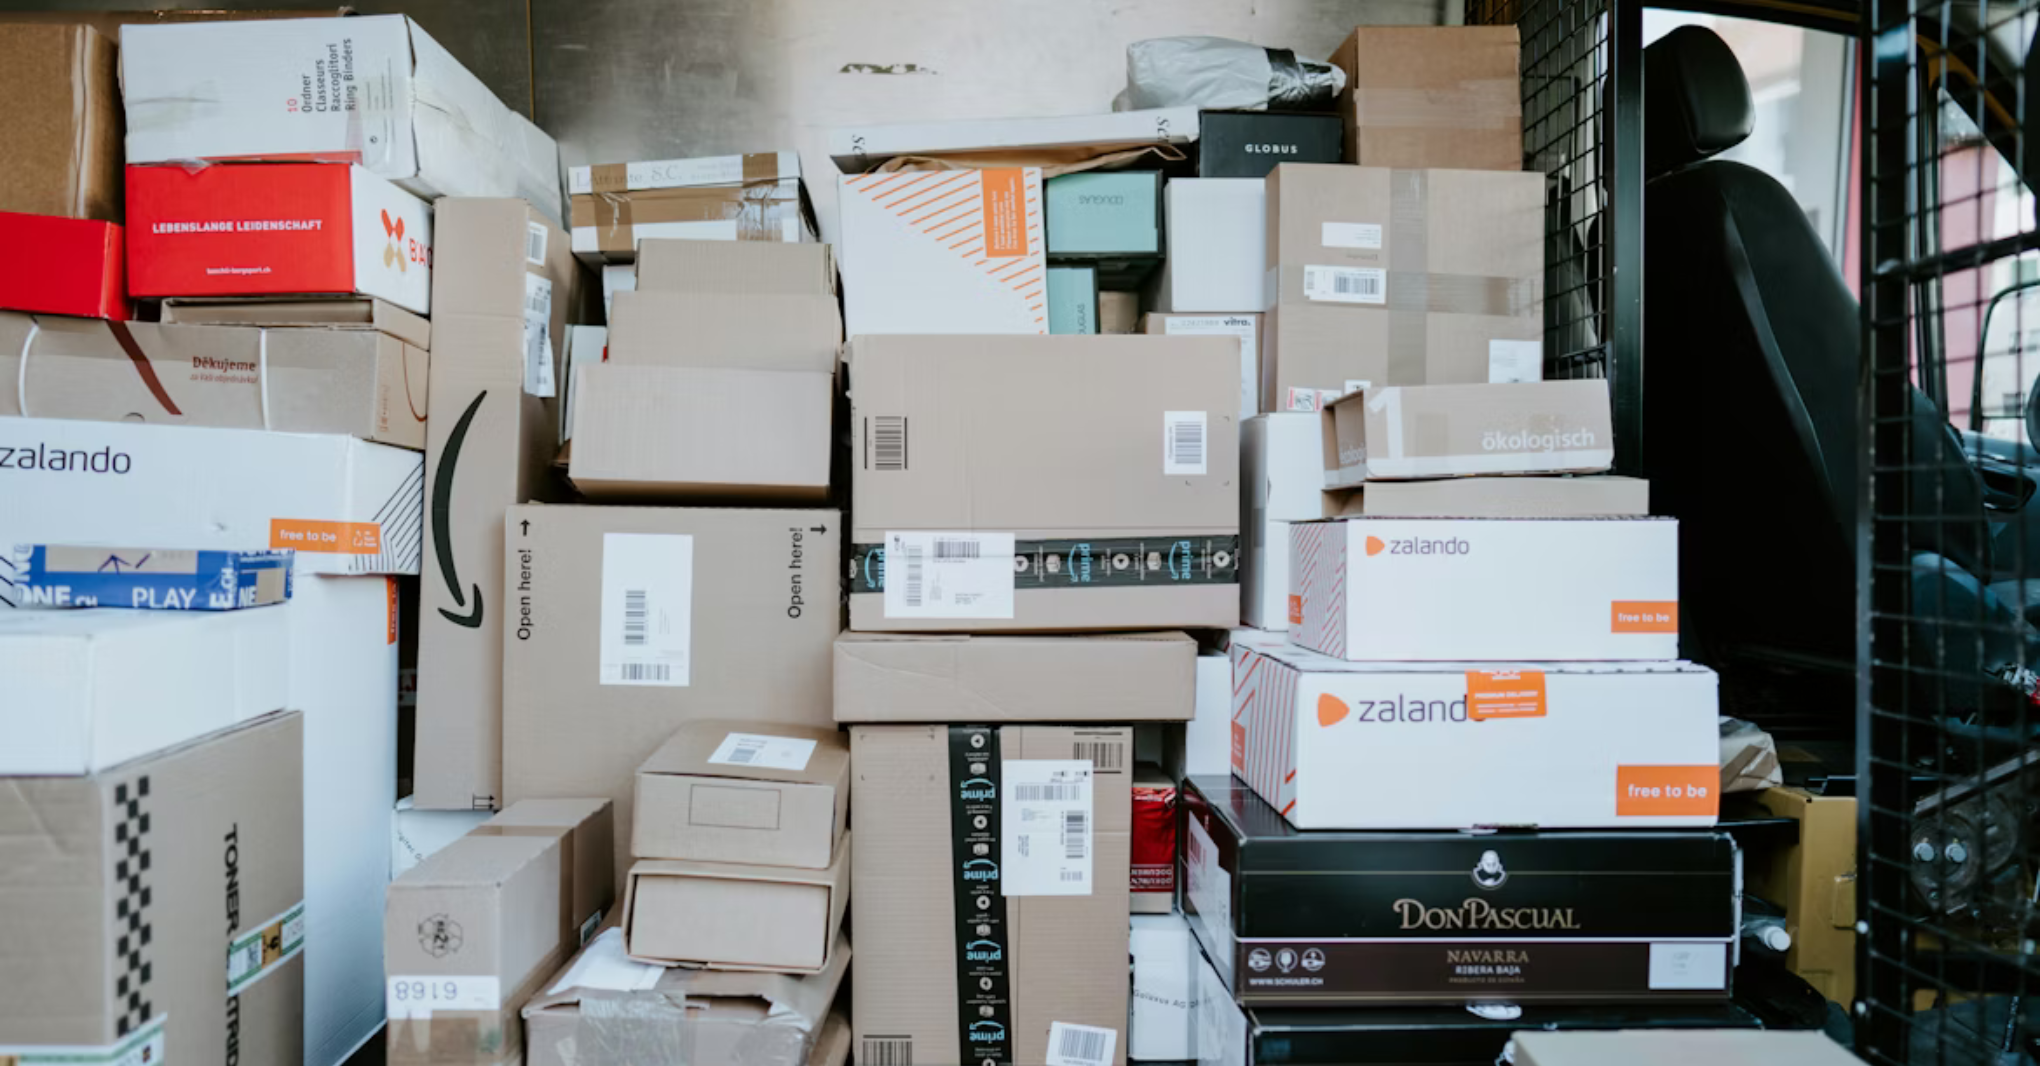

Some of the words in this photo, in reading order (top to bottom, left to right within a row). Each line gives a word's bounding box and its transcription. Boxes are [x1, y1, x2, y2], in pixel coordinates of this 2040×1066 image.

[342, 38, 354, 81] Binders
[315, 59, 327, 112] Classeurs
[326, 43, 342, 112] Raccoglitori
[300, 74, 313, 113] Ordner
[344, 85, 358, 111] Ring
[286, 98, 298, 112] 10
[1244, 143, 1299, 155] GLOBUS
[152, 220, 235, 234] LEBENSLANGE
[236, 218, 323, 232] LEIDENSCHAFT
[191, 355, 257, 374] Děkujeme
[1482, 427, 1596, 451] ökologisch
[0, 442, 132, 475] zalando
[279, 528, 304, 541] free
[306, 529, 318, 541] to
[320, 531, 337, 543] be
[1389, 535, 1470, 556] zalando
[788, 527, 803, 569] here!
[518, 549, 533, 591] here!
[1077, 542, 1094, 582] prime
[1178, 540, 1194, 580] prime
[132, 587, 198, 609] PLAY
[787, 573, 804, 619] Open
[517, 595, 534, 641] Open
[1617, 612, 1640, 623] free
[1641, 613, 1654, 623] to
[1655, 612, 1670, 623] be
[1359, 693, 1484, 722] zaland
[960, 786, 996, 800] prime
[1628, 783, 1661, 797] free
[1665, 784, 1683, 797] to
[1686, 783, 1708, 797] be
[223, 822, 240, 936] TONER
[963, 866, 999, 881] prime
[967, 946, 1002, 962] prime
[1446, 949, 1530, 964] NAVARRA
[1248, 977, 1324, 986] WWW.SCHULER.CH
[1455, 965, 1495, 975] RIBERA
[1496, 965, 1522, 976] BAJA
[969, 1028, 1005, 1042] prime
